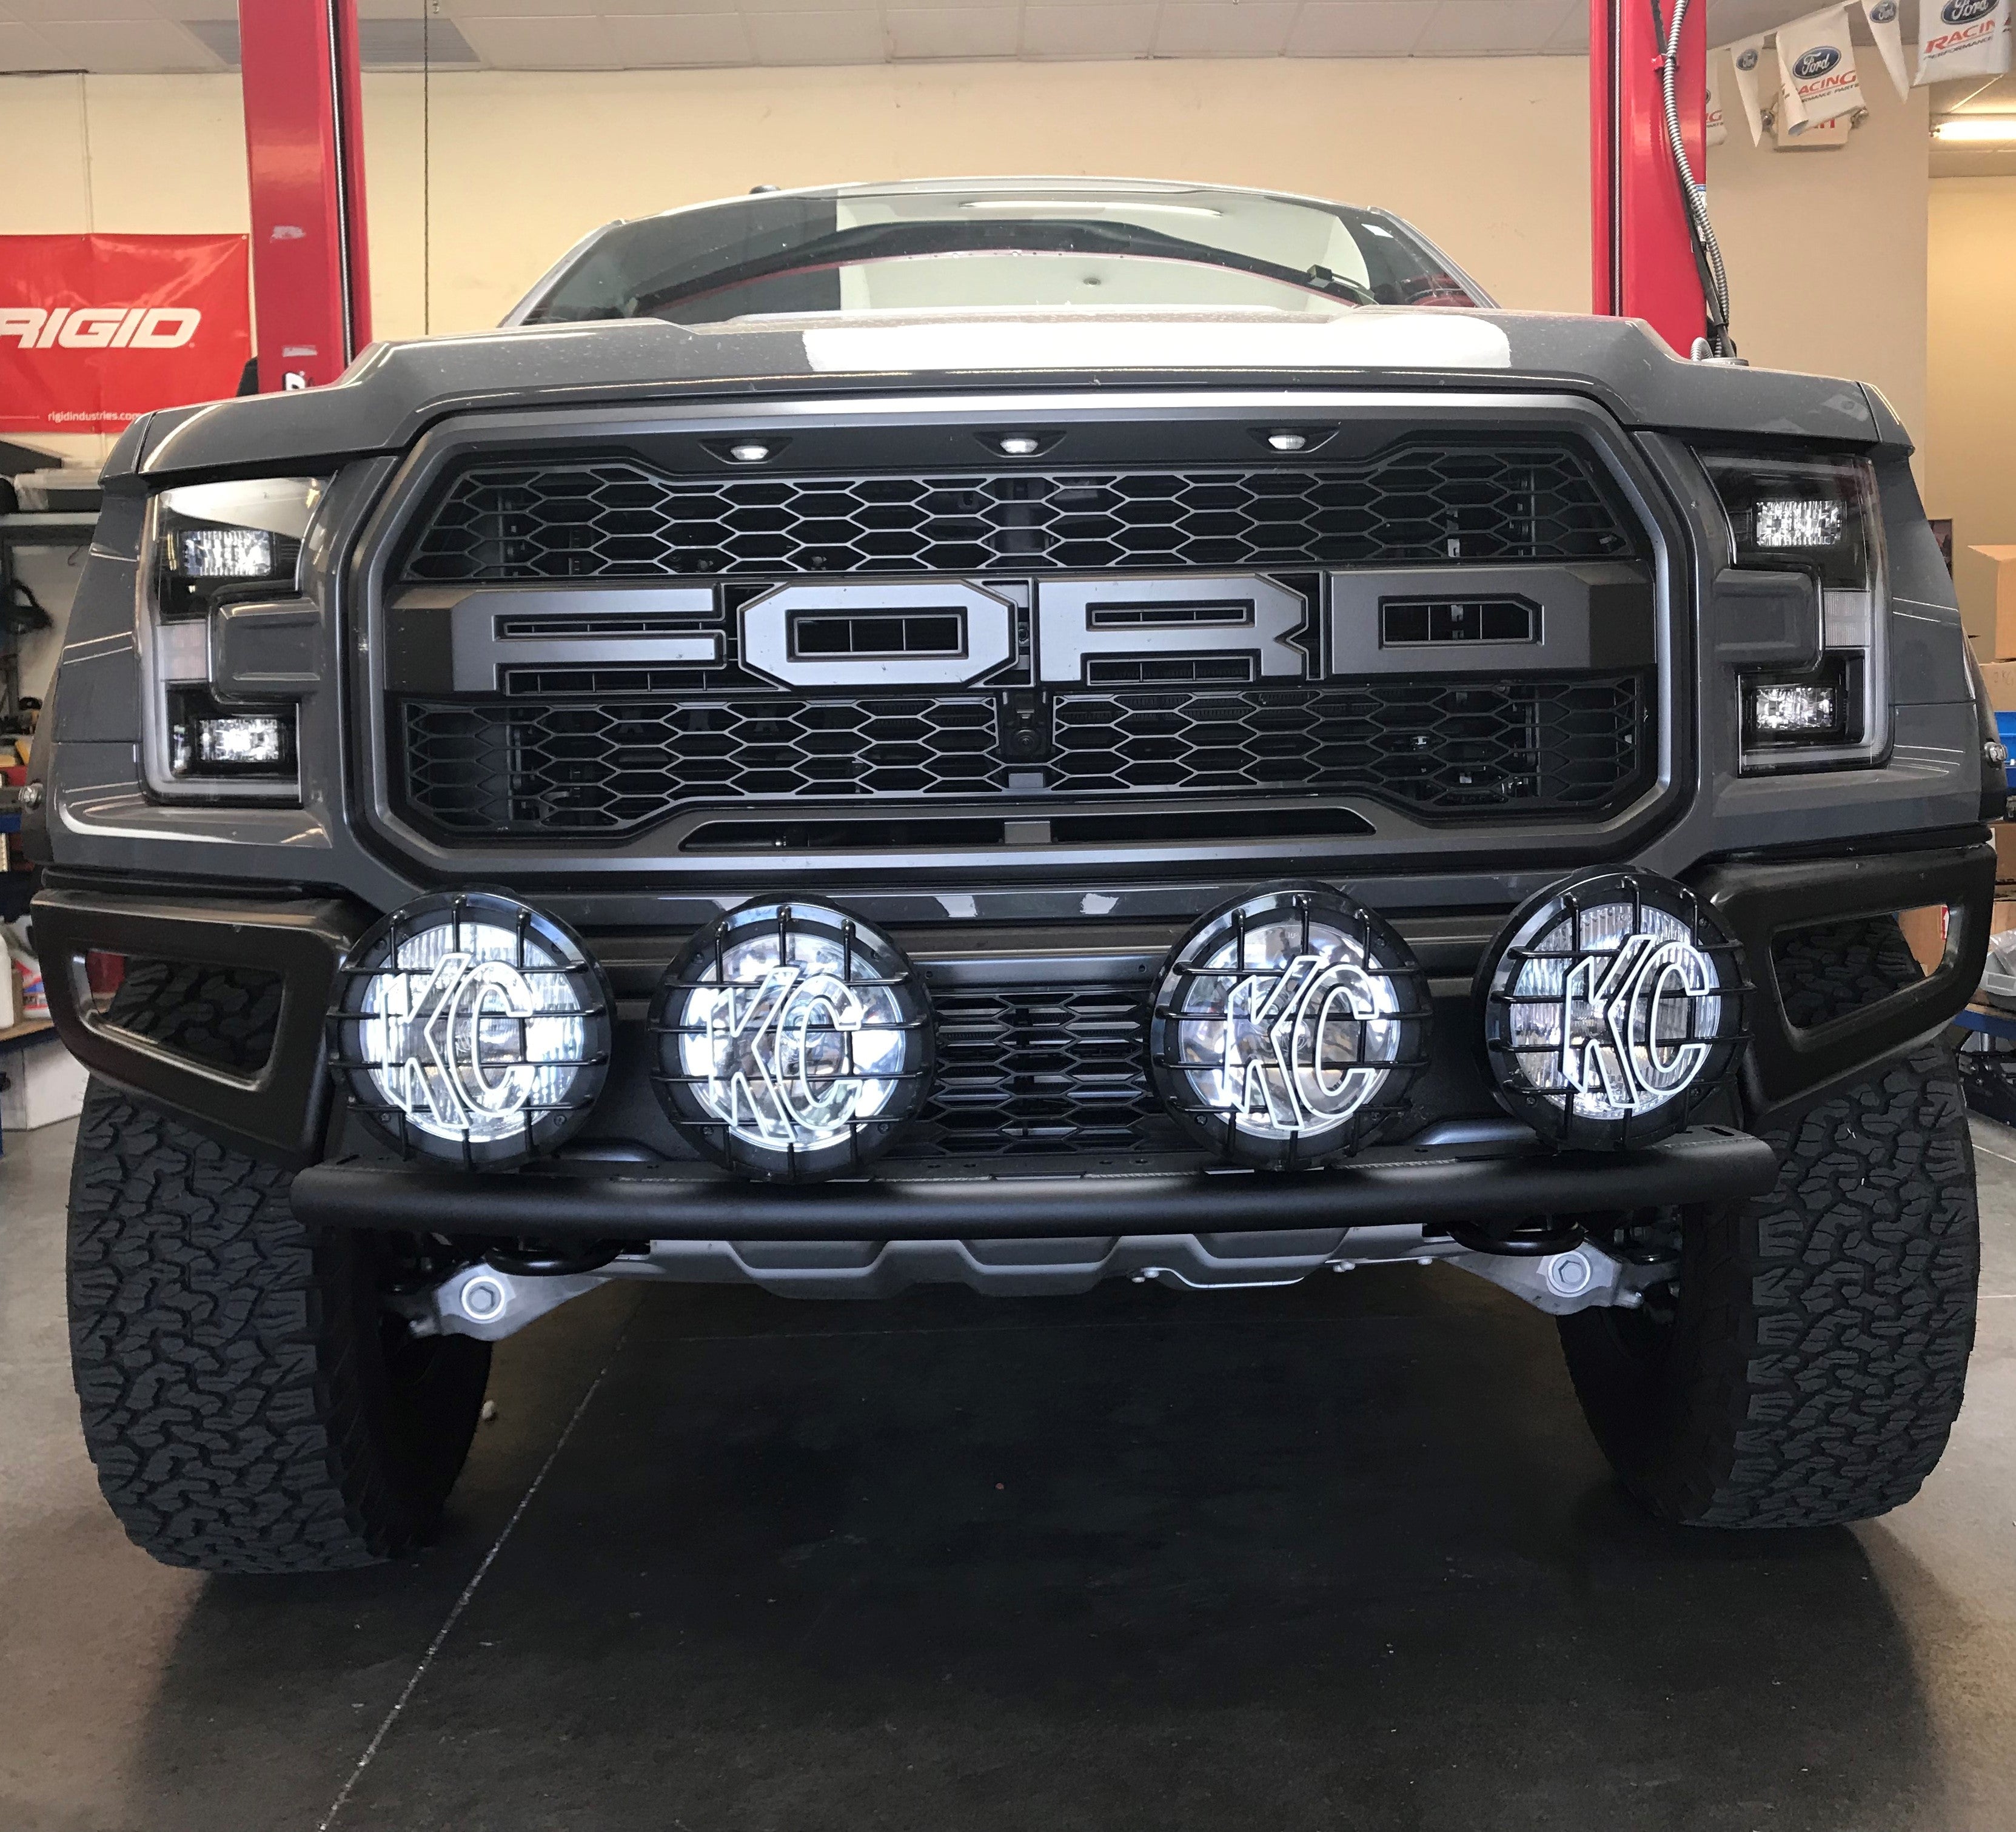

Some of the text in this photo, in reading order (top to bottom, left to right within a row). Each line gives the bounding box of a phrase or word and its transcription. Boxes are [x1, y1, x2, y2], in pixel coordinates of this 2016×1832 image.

[1802, 52, 1830, 75] Ford
[1952, 0, 1989, 20] Ford
[1798, 70, 1857, 95] ACING
[0, 307, 201, 349] RIGID
[388, 570, 1650, 694] FORD
[380, 952, 535, 1129] KC
[708, 965, 863, 1141] KC
[1225, 955, 1379, 1130] KC
[1562, 934, 1710, 1109] KC
